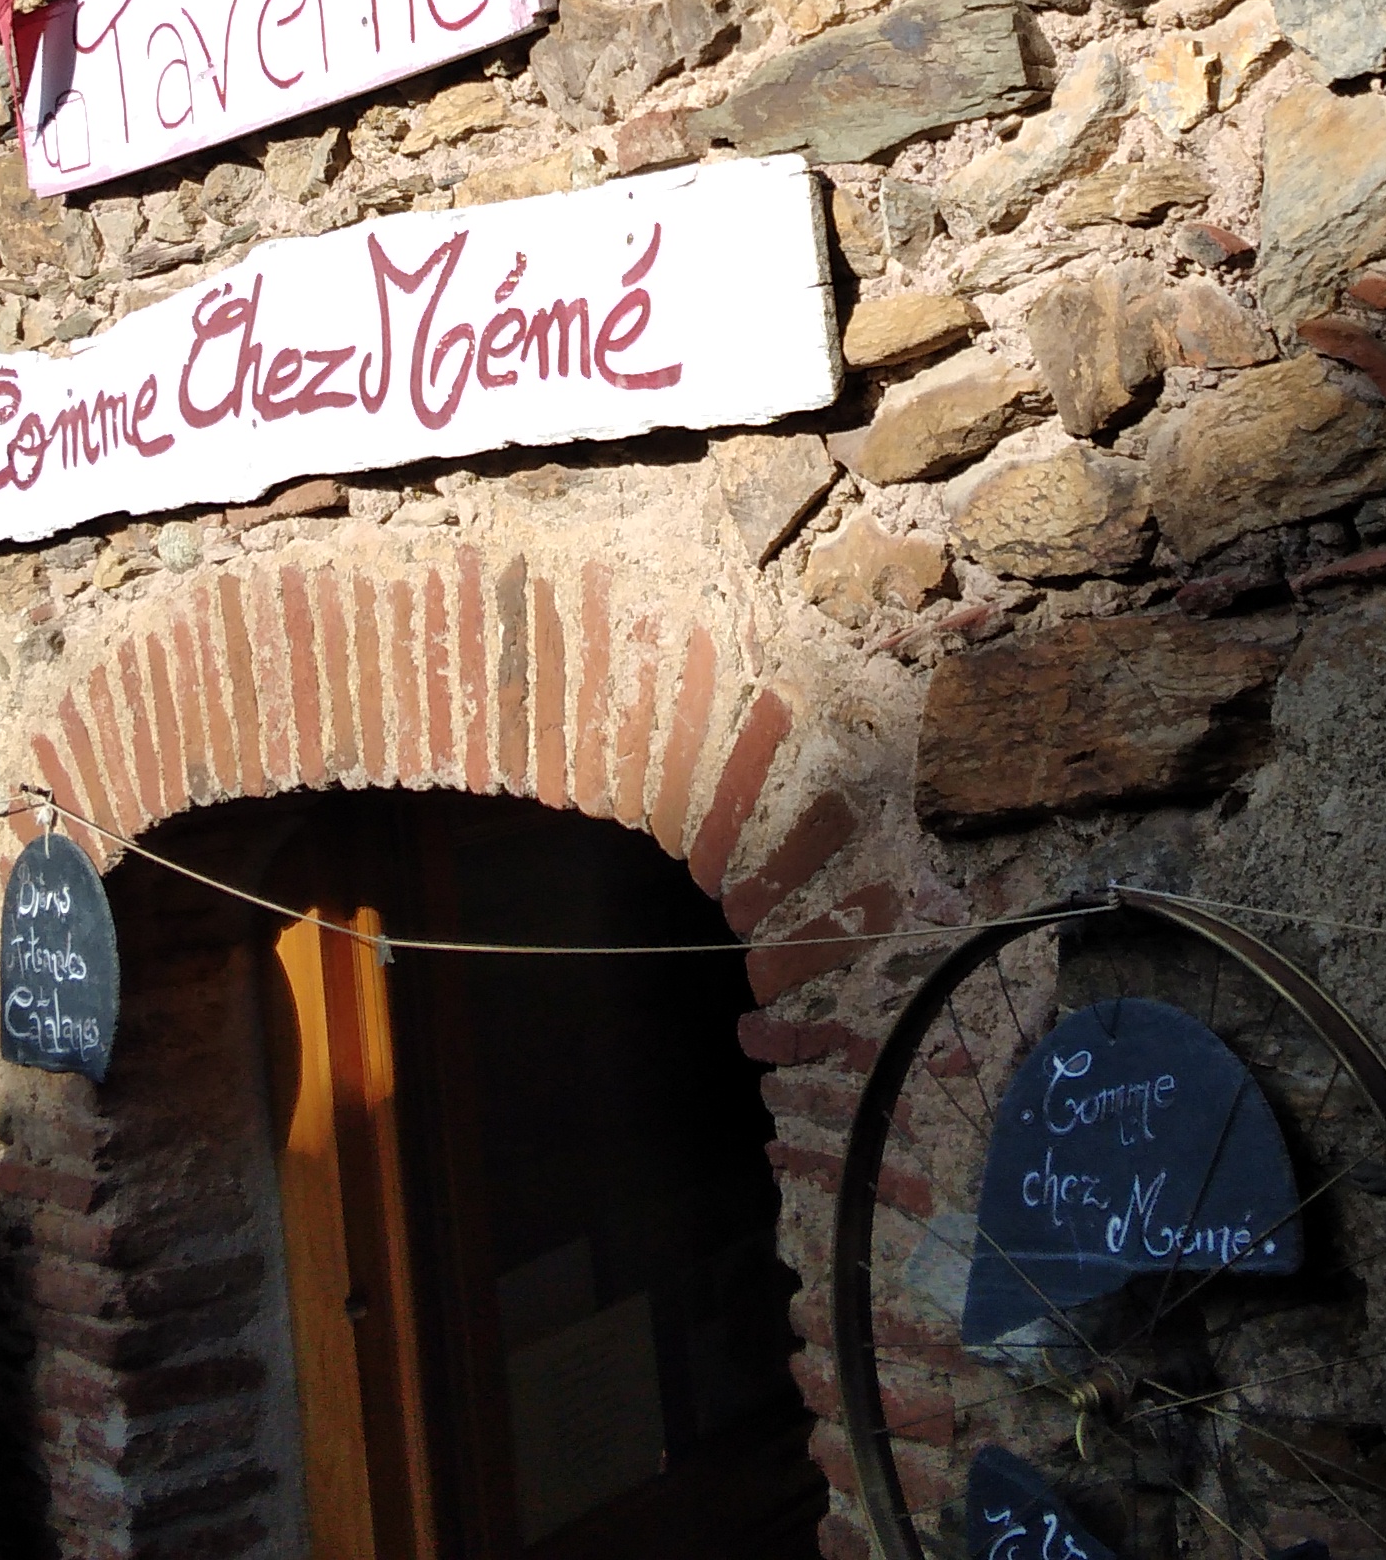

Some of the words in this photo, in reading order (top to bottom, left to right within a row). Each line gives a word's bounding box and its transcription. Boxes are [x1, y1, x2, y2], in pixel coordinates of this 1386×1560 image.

[179, 272, 359, 428] Chez
[360, 221, 683, 430] Mémé
[1043, 1050, 1175, 1146] Comme
[1023, 1146, 1108, 1226] chez
